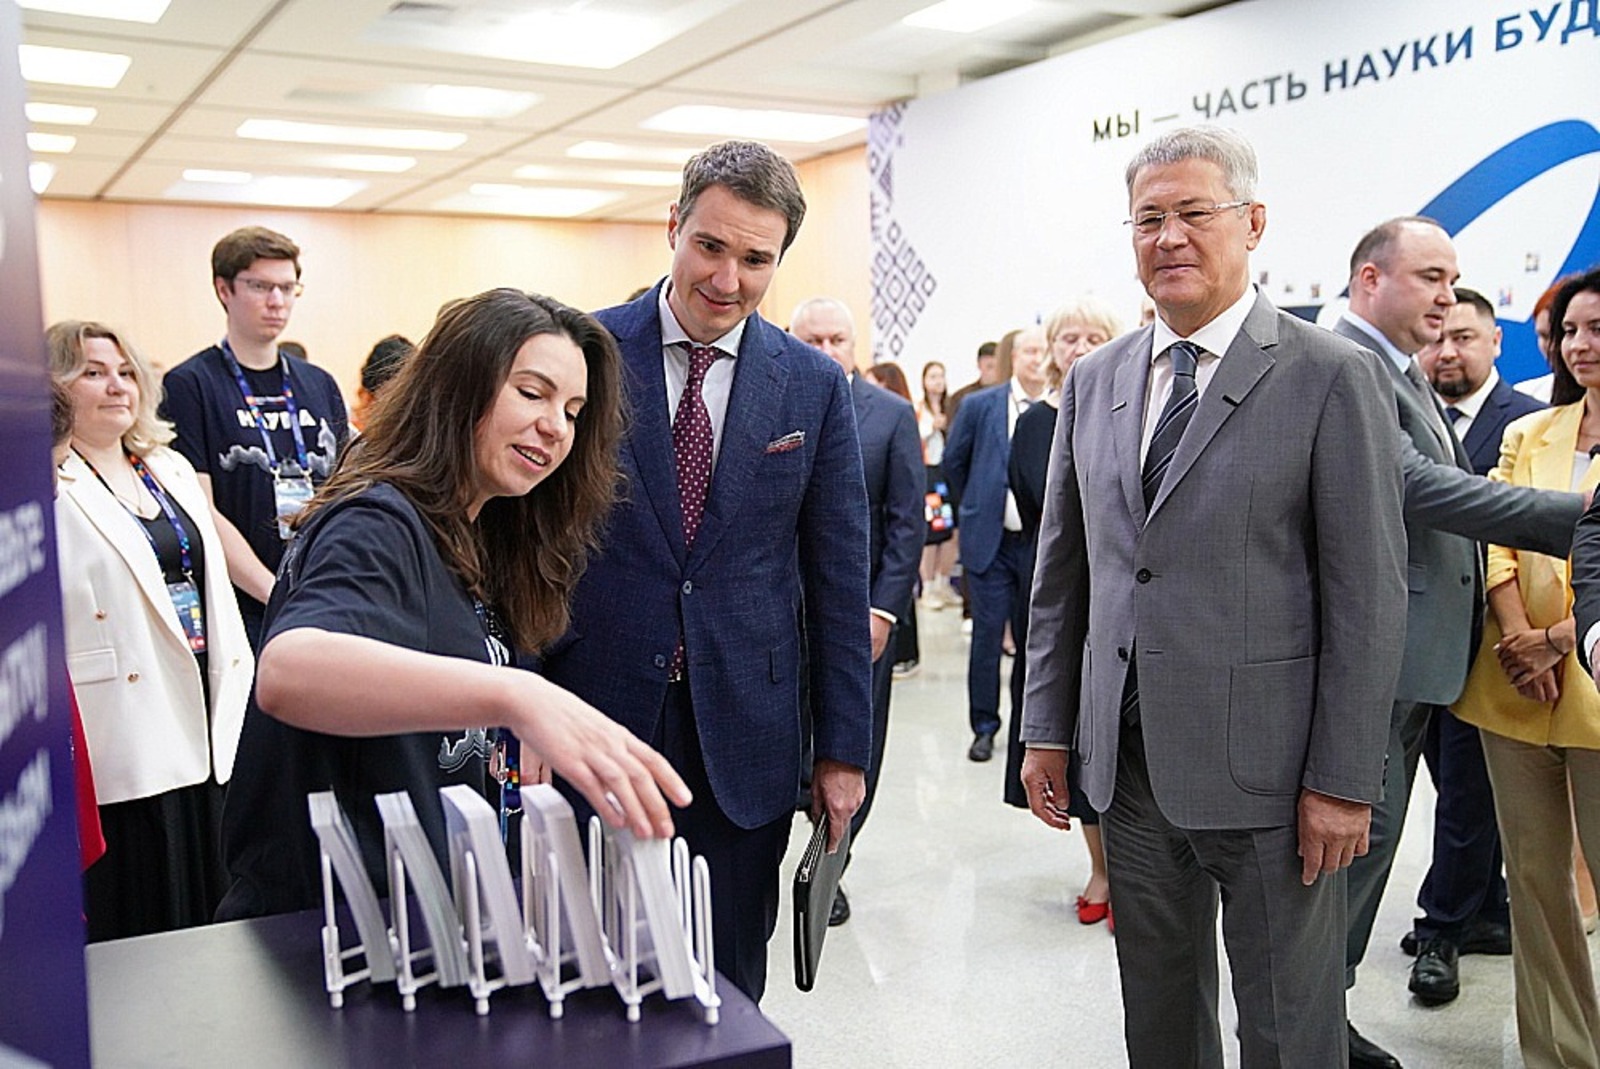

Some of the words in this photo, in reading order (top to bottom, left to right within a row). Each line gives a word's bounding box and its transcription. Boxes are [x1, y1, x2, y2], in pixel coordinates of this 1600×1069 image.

[1093, 109, 1139, 142] МЫ
[1192, 73, 1307, 119] ЧАСТЬ
[1323, 25, 1474, 93] НАУКИ
